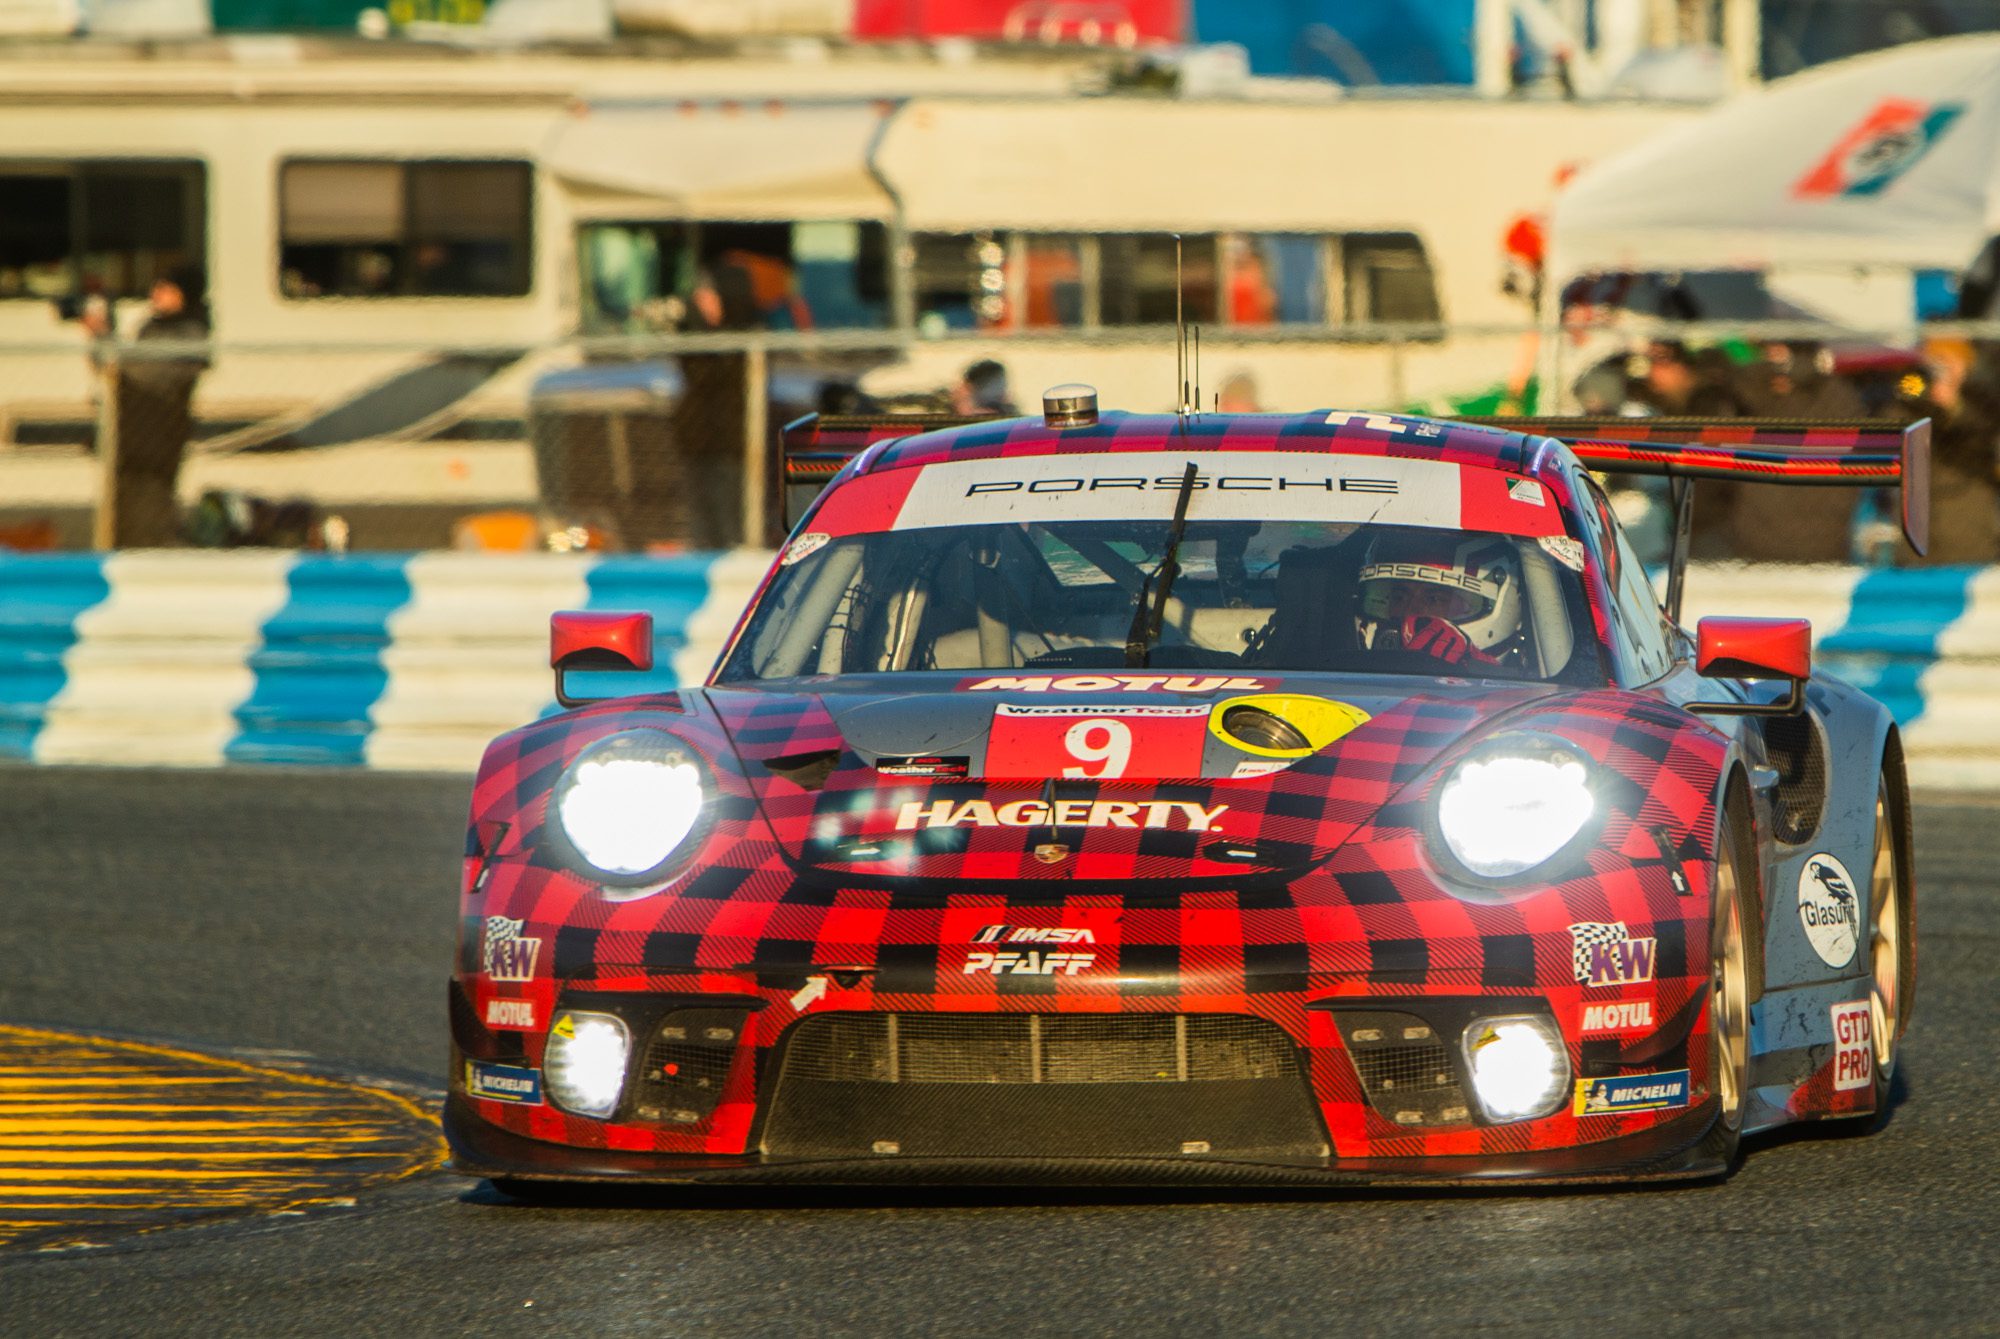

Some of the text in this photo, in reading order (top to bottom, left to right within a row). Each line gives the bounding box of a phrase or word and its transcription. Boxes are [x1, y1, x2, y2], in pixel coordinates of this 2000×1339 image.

[964, 477, 1399, 497] PORSCHE
[969, 676, 1265, 692] MOTUL
[1006, 706, 1202, 714] WeatherTech
[1062, 718, 1132, 778] 9
[1009, 927, 1096, 944] IMSA
[490, 938, 542, 981] KW
[963, 952, 1096, 976] PFAFF
[1588, 937, 1657, 987] KW
[487, 1000, 535, 1027] MOTUL
[1581, 1002, 1653, 1031] MOTUL
[1836, 1010, 1870, 1045] GTD
[1838, 1049, 1870, 1081] PRO
[1611, 1082, 1681, 1103] MICHELIN
